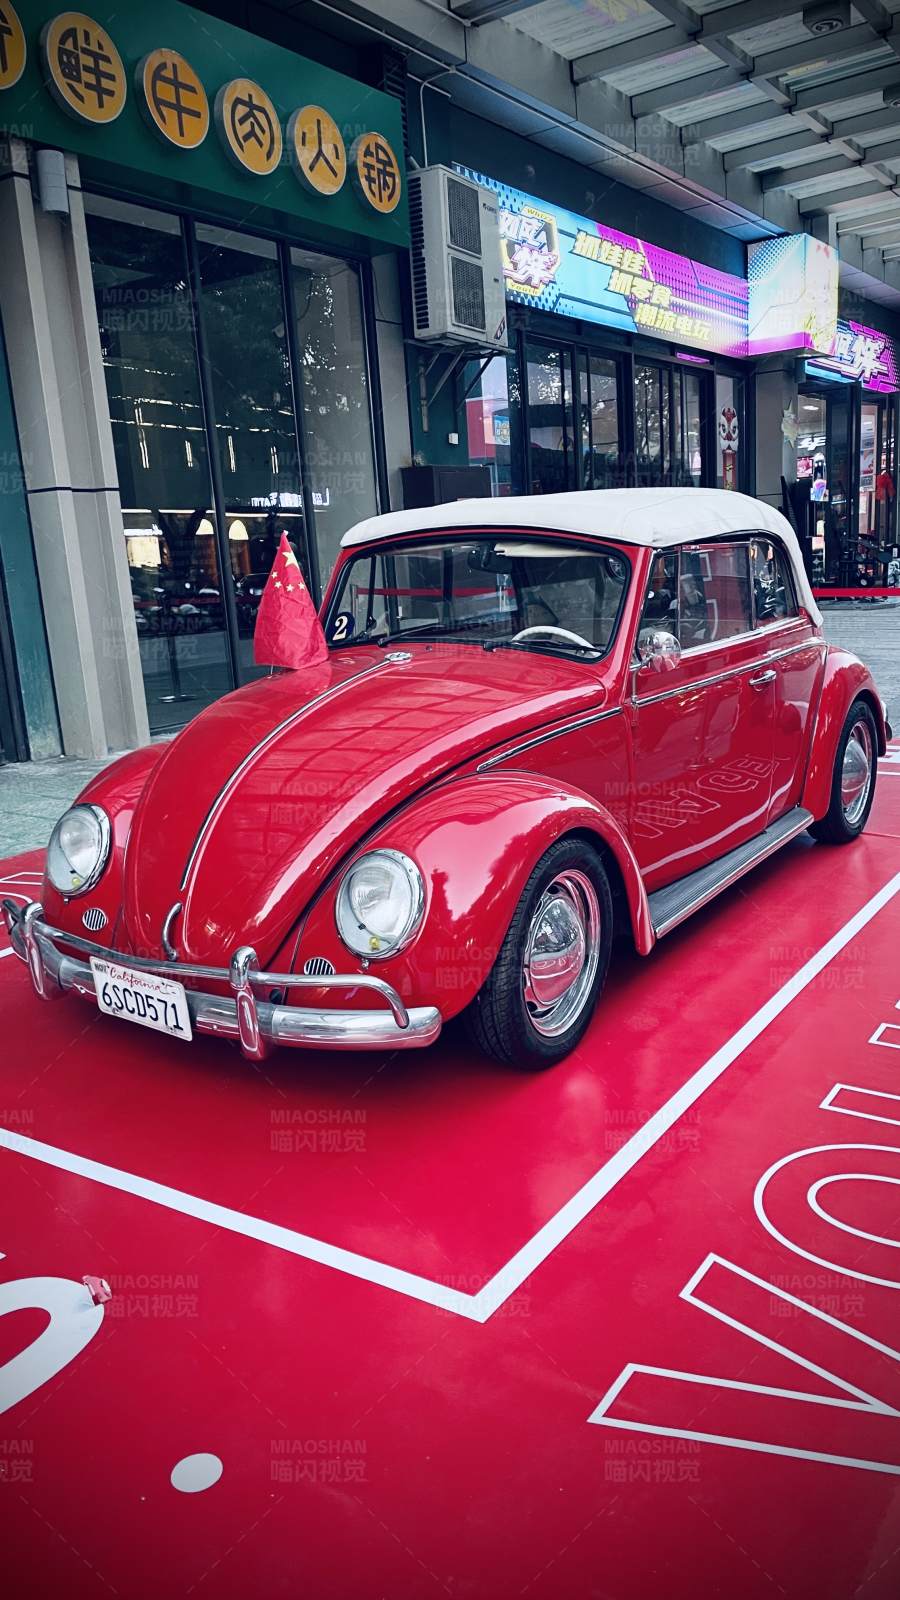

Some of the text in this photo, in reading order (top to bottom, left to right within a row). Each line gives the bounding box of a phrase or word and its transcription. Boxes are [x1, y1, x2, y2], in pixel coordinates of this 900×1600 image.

[573, 230, 646, 275] 抓娃娃
[607, 269, 672, 309] 抓零食
[634, 302, 713, 341] 潮流电玩
[333, 615, 348, 641] 2
[110, 966, 161, 991] California
[102, 982, 184, 1031] 6SCD571
